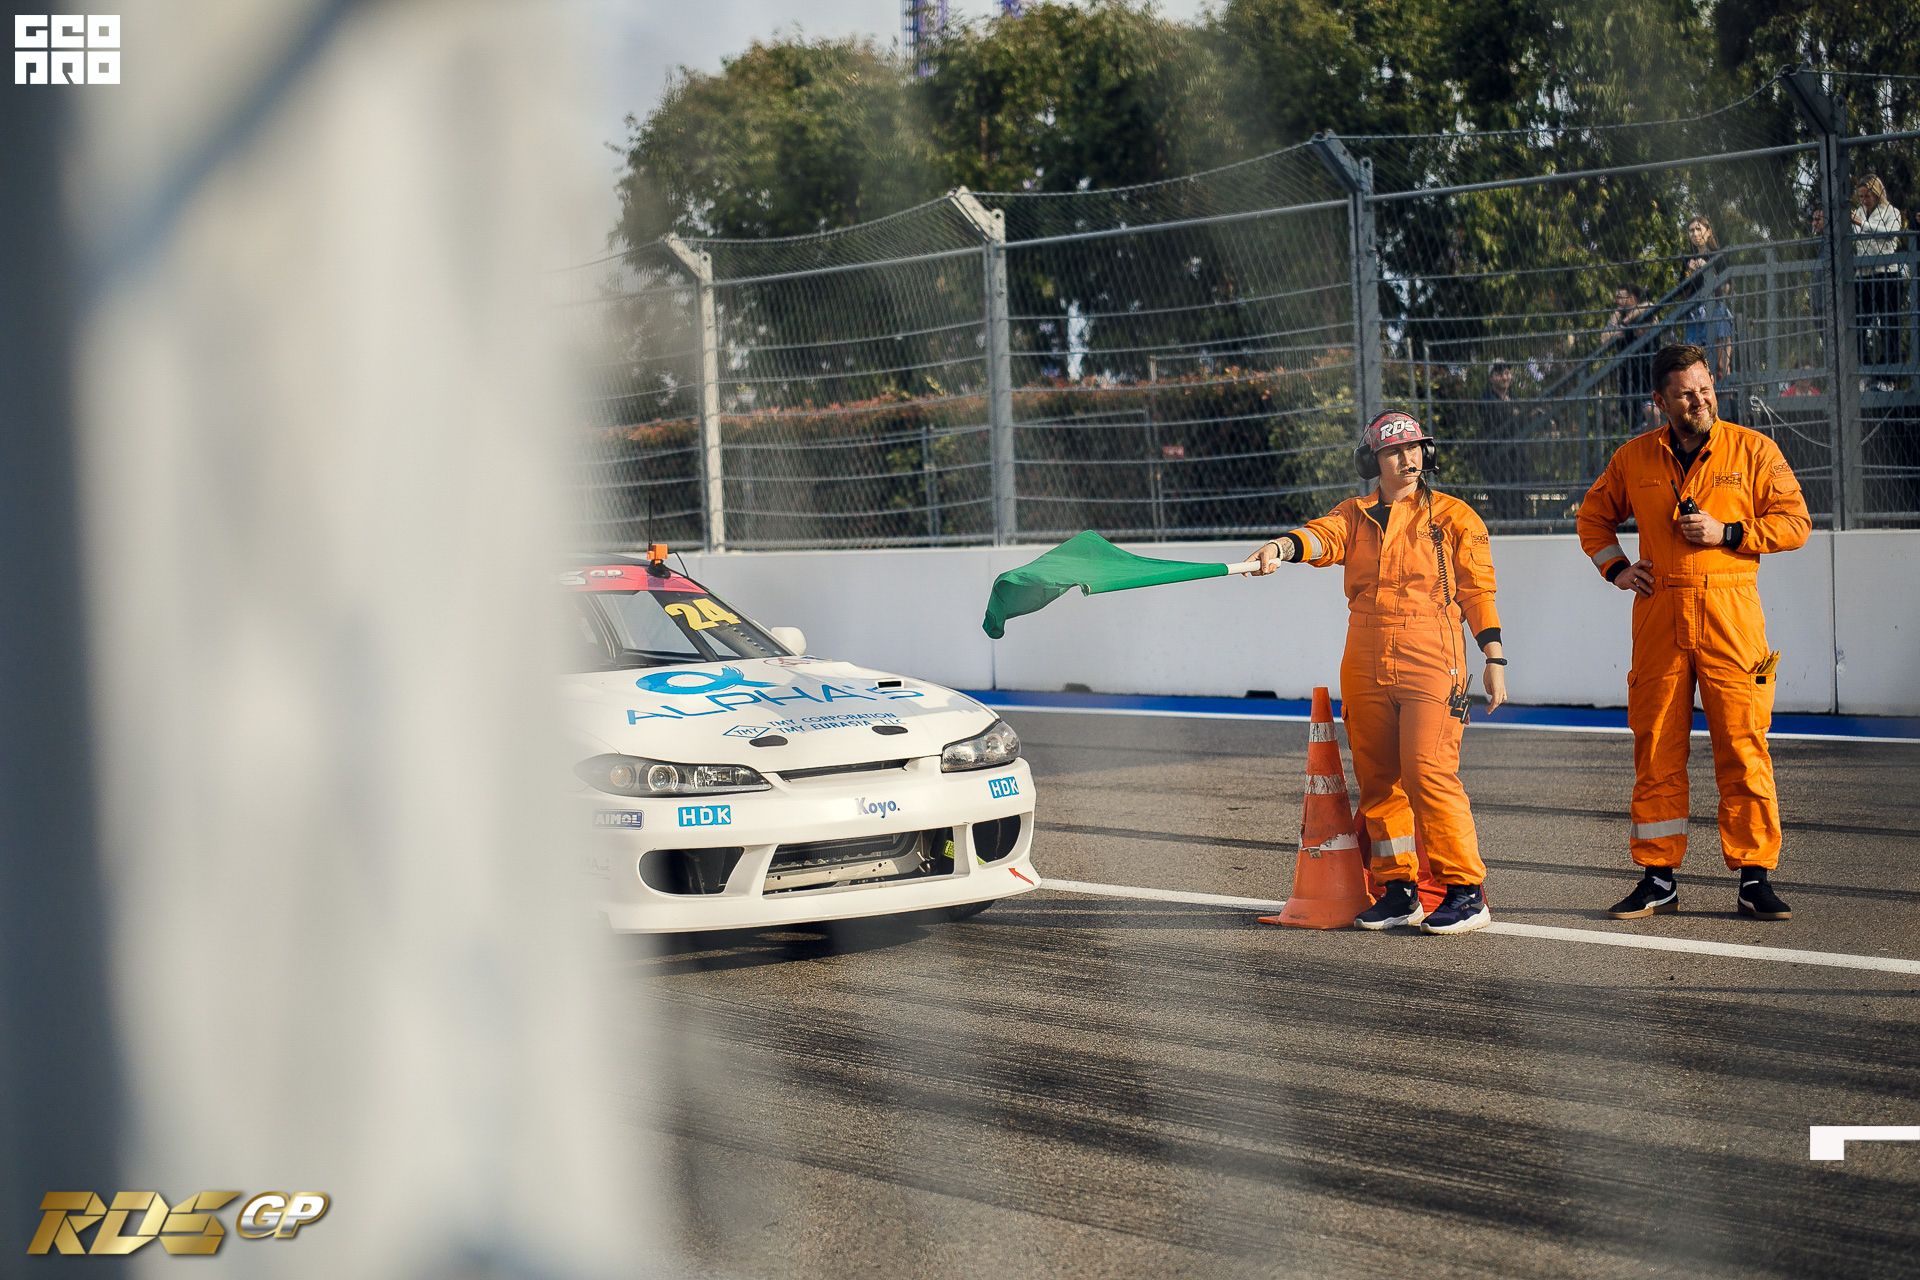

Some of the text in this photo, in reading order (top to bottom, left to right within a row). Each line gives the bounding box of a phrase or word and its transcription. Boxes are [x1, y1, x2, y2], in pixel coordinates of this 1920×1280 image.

[1380, 420, 1416, 440] RDS
[664, 598, 742, 631] 24
[627, 684, 925, 725] ALPHA'S
[767, 712, 897, 727] TMY CORPORATION
[776, 724, 806, 734] TMY
[810, 719, 873, 731] EURASIA
[734, 727, 759, 737] TMY
[991, 778, 1019, 798] HDK
[594, 812, 641, 826] AIMOL
[681, 807, 731, 826] HDK
